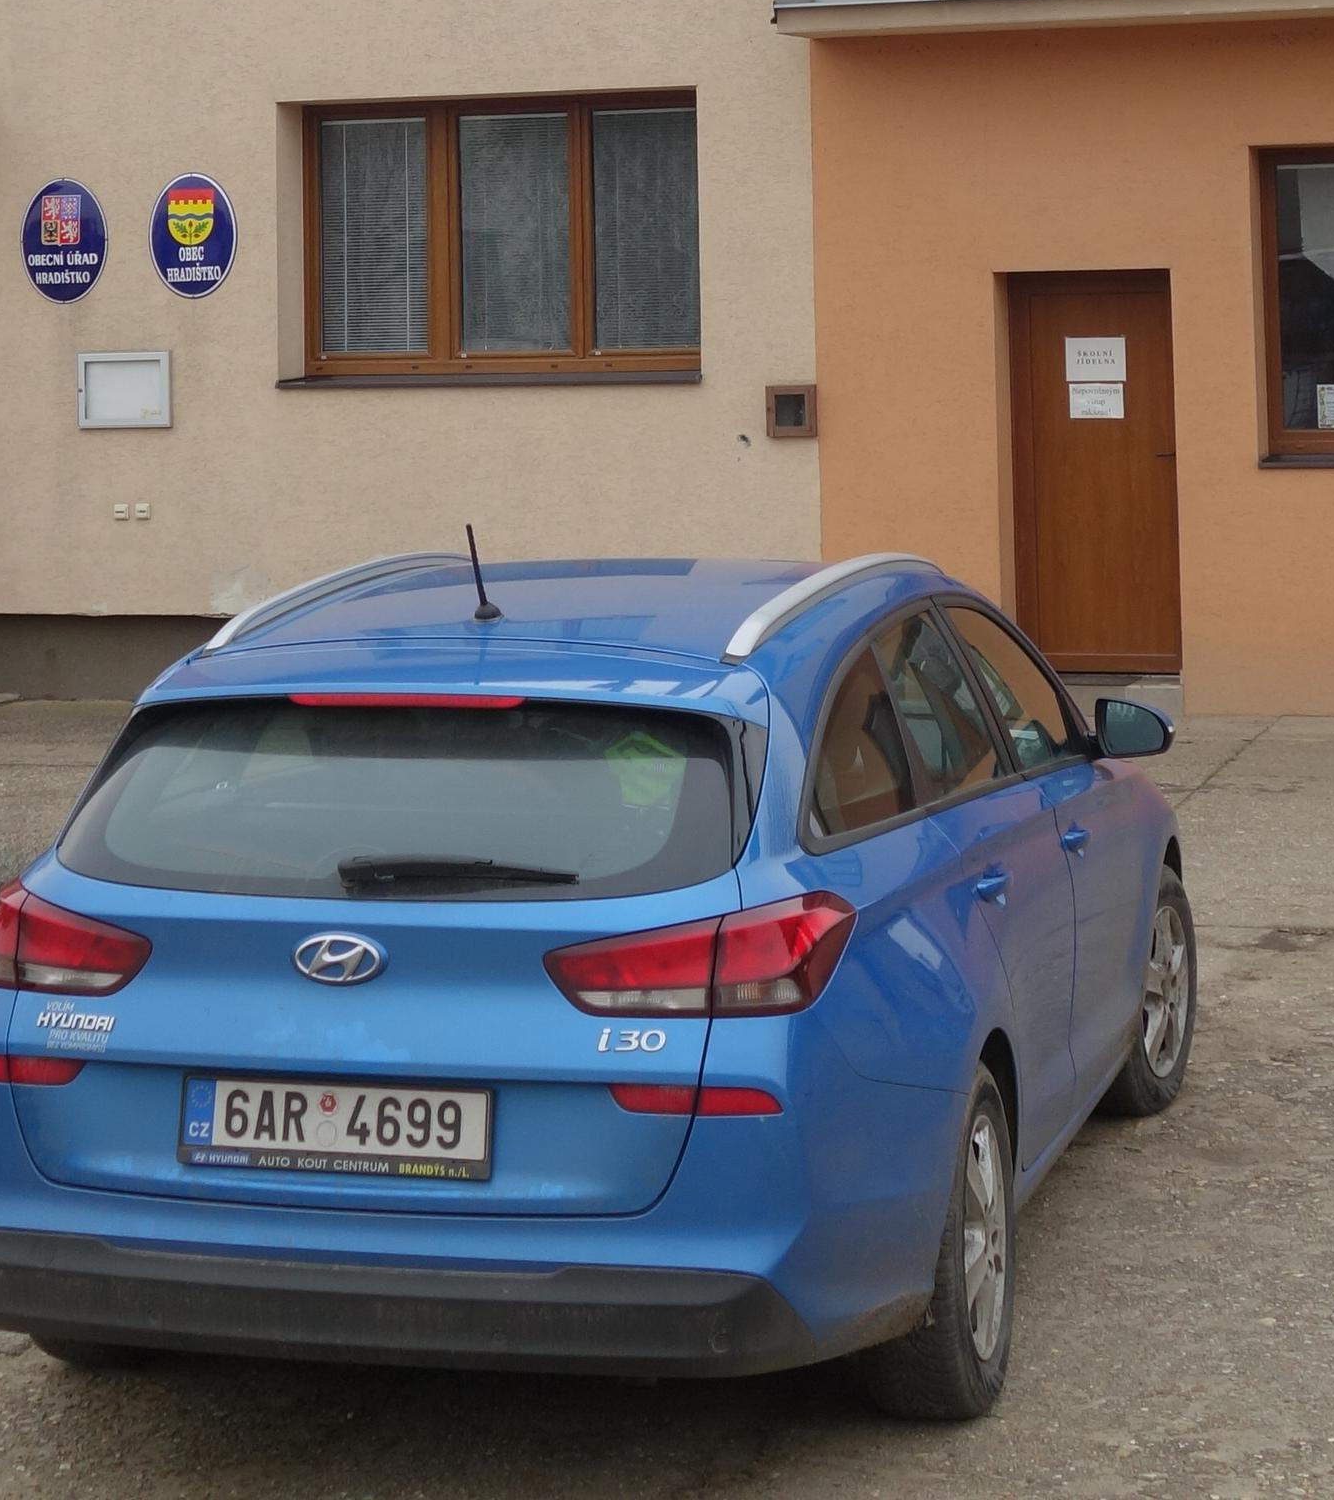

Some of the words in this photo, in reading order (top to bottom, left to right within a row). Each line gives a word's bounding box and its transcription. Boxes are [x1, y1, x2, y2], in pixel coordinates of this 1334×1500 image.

[28, 251, 64, 267] OBECNÍ
[67, 250, 98, 266] ÚŘAD
[179, 247, 205, 262] OBEC
[35, 269, 91, 285] HRADIŠTKO
[167, 263, 221, 283] HRADIŠTKO
[1077, 349, 1113, 357] ŠKOLNÍ
[46, 1000, 75, 1012] VOLÍM
[36, 1012, 116, 1031] HYUNDAI
[48, 1029, 67, 1041] PRO
[69, 1031, 109, 1043] KVALITU
[224, 1089, 308, 1143] 6AR
[346, 1094, 462, 1150] 4699
[188, 1121, 210, 1139] CZ
[209, 1153, 249, 1165] HYUNDAI
[258, 1155, 291, 1167] AUTO
[297, 1158, 328, 1169] KOUT
[333, 1159, 390, 1173] CENTRUM
[398, 1163, 445, 1176] BRANDÝS
